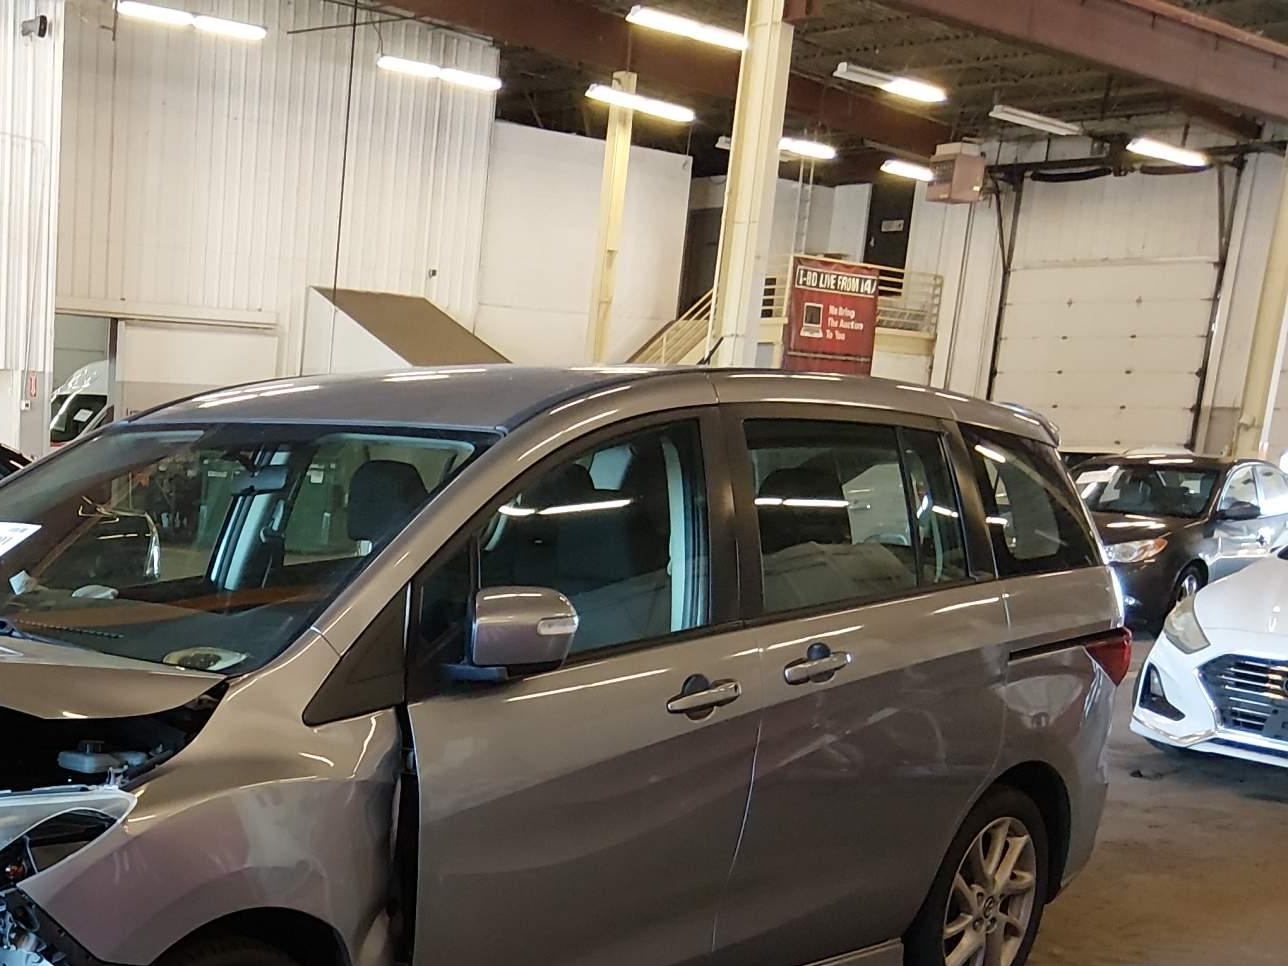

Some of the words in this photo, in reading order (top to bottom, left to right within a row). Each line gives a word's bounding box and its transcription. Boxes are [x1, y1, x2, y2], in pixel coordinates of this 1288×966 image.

[819, 272, 837, 289] LIVE
[837, 275, 860, 292] FROM
[839, 318, 864, 330] Auction
[826, 329, 833, 339] To
[835, 330, 846, 341] You
